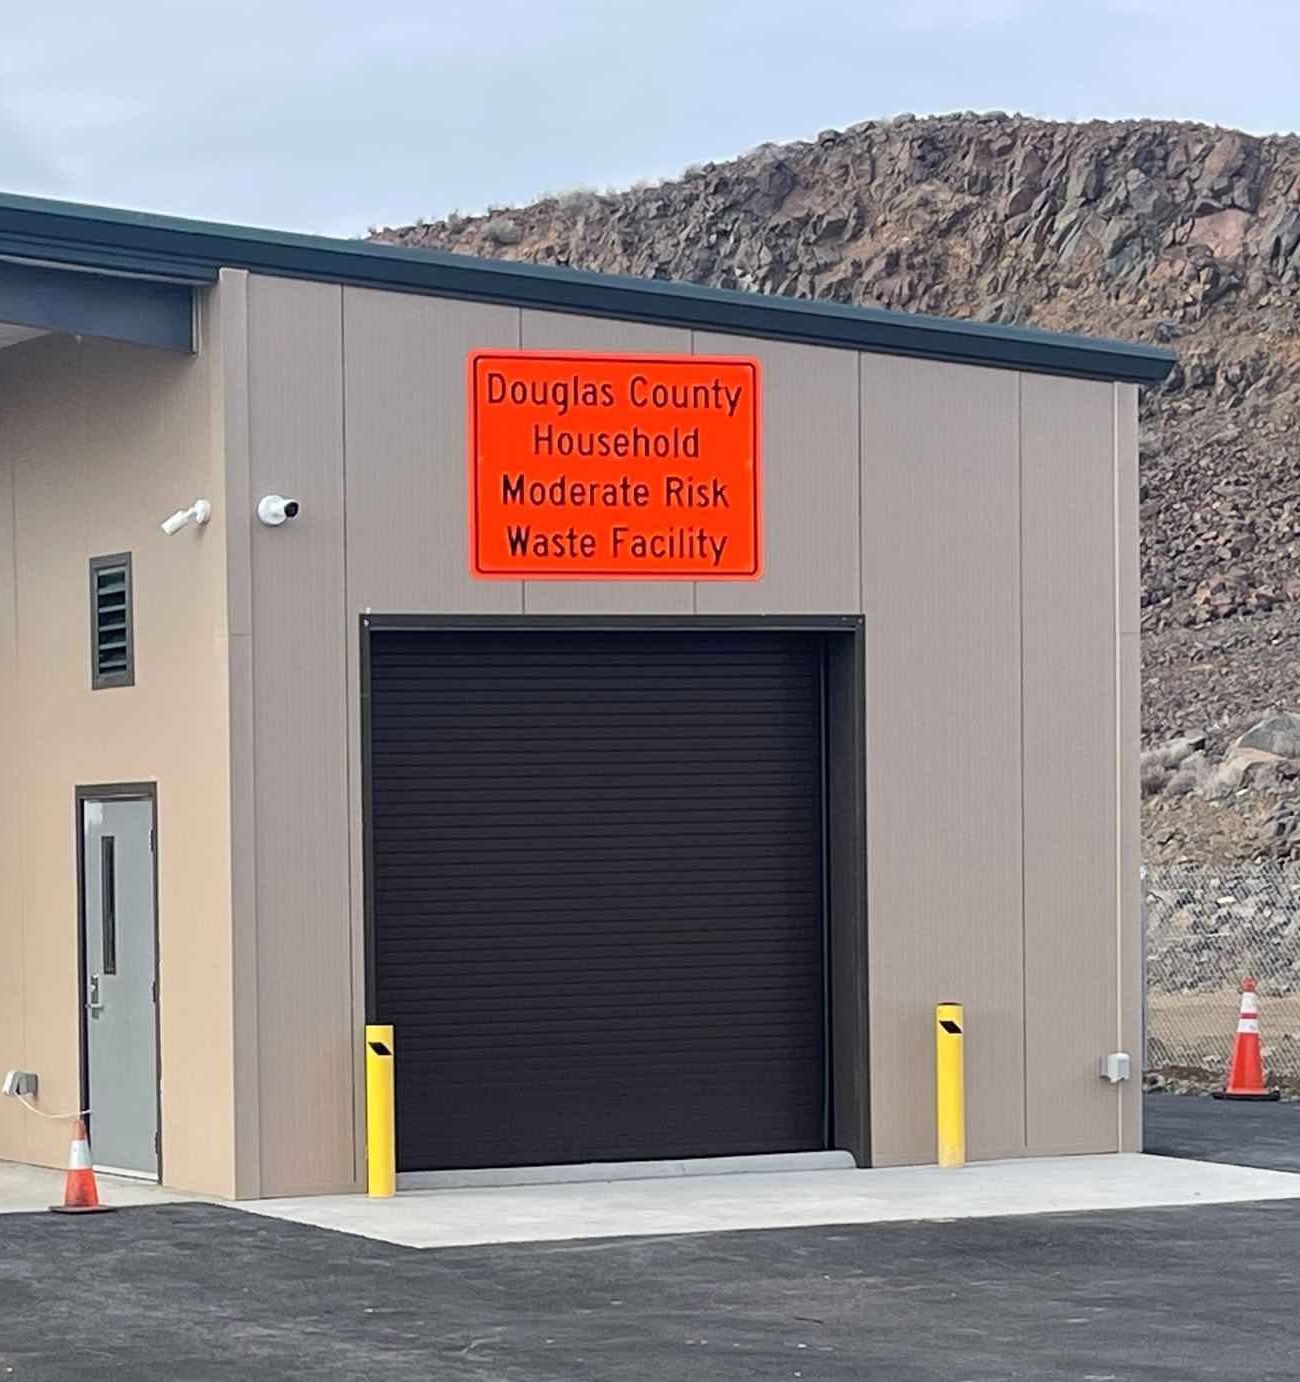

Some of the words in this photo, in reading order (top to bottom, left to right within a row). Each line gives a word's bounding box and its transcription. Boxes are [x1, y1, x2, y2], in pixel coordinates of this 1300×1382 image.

[487, 372, 614, 416] Douglas
[629, 375, 742, 417] County
[533, 424, 700, 458] Household
[502, 474, 650, 508] Moderate
[665, 476, 729, 509] Risk
[506, 525, 596, 558] Waste
[611, 526, 728, 566] Facility
